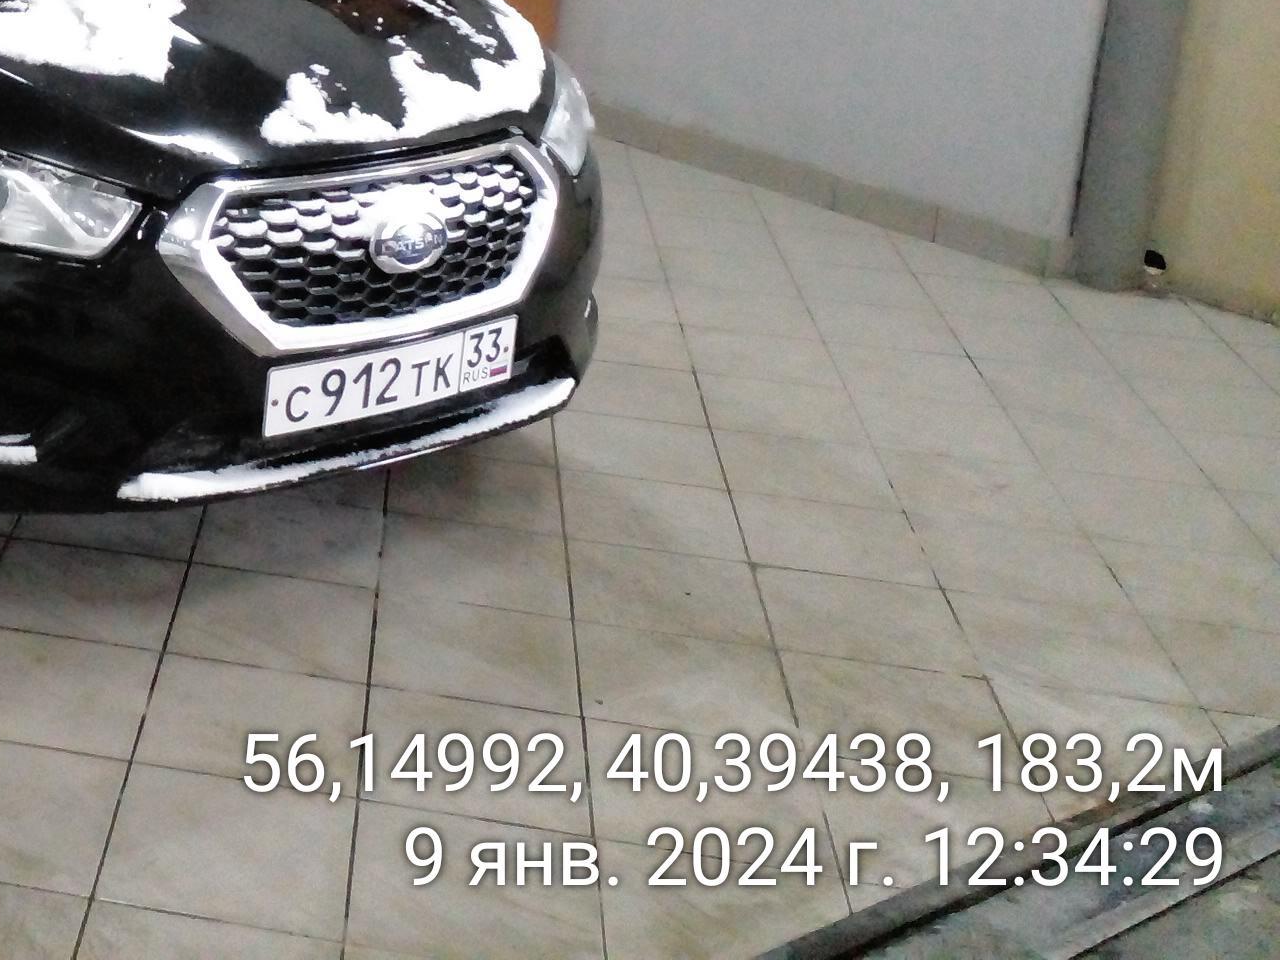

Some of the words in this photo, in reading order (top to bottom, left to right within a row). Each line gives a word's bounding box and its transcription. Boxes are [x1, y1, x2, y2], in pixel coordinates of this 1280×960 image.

[285, 353, 454, 423] С912ТК
[467, 327, 503, 368] 33
[462, 366, 489, 385] RUS
